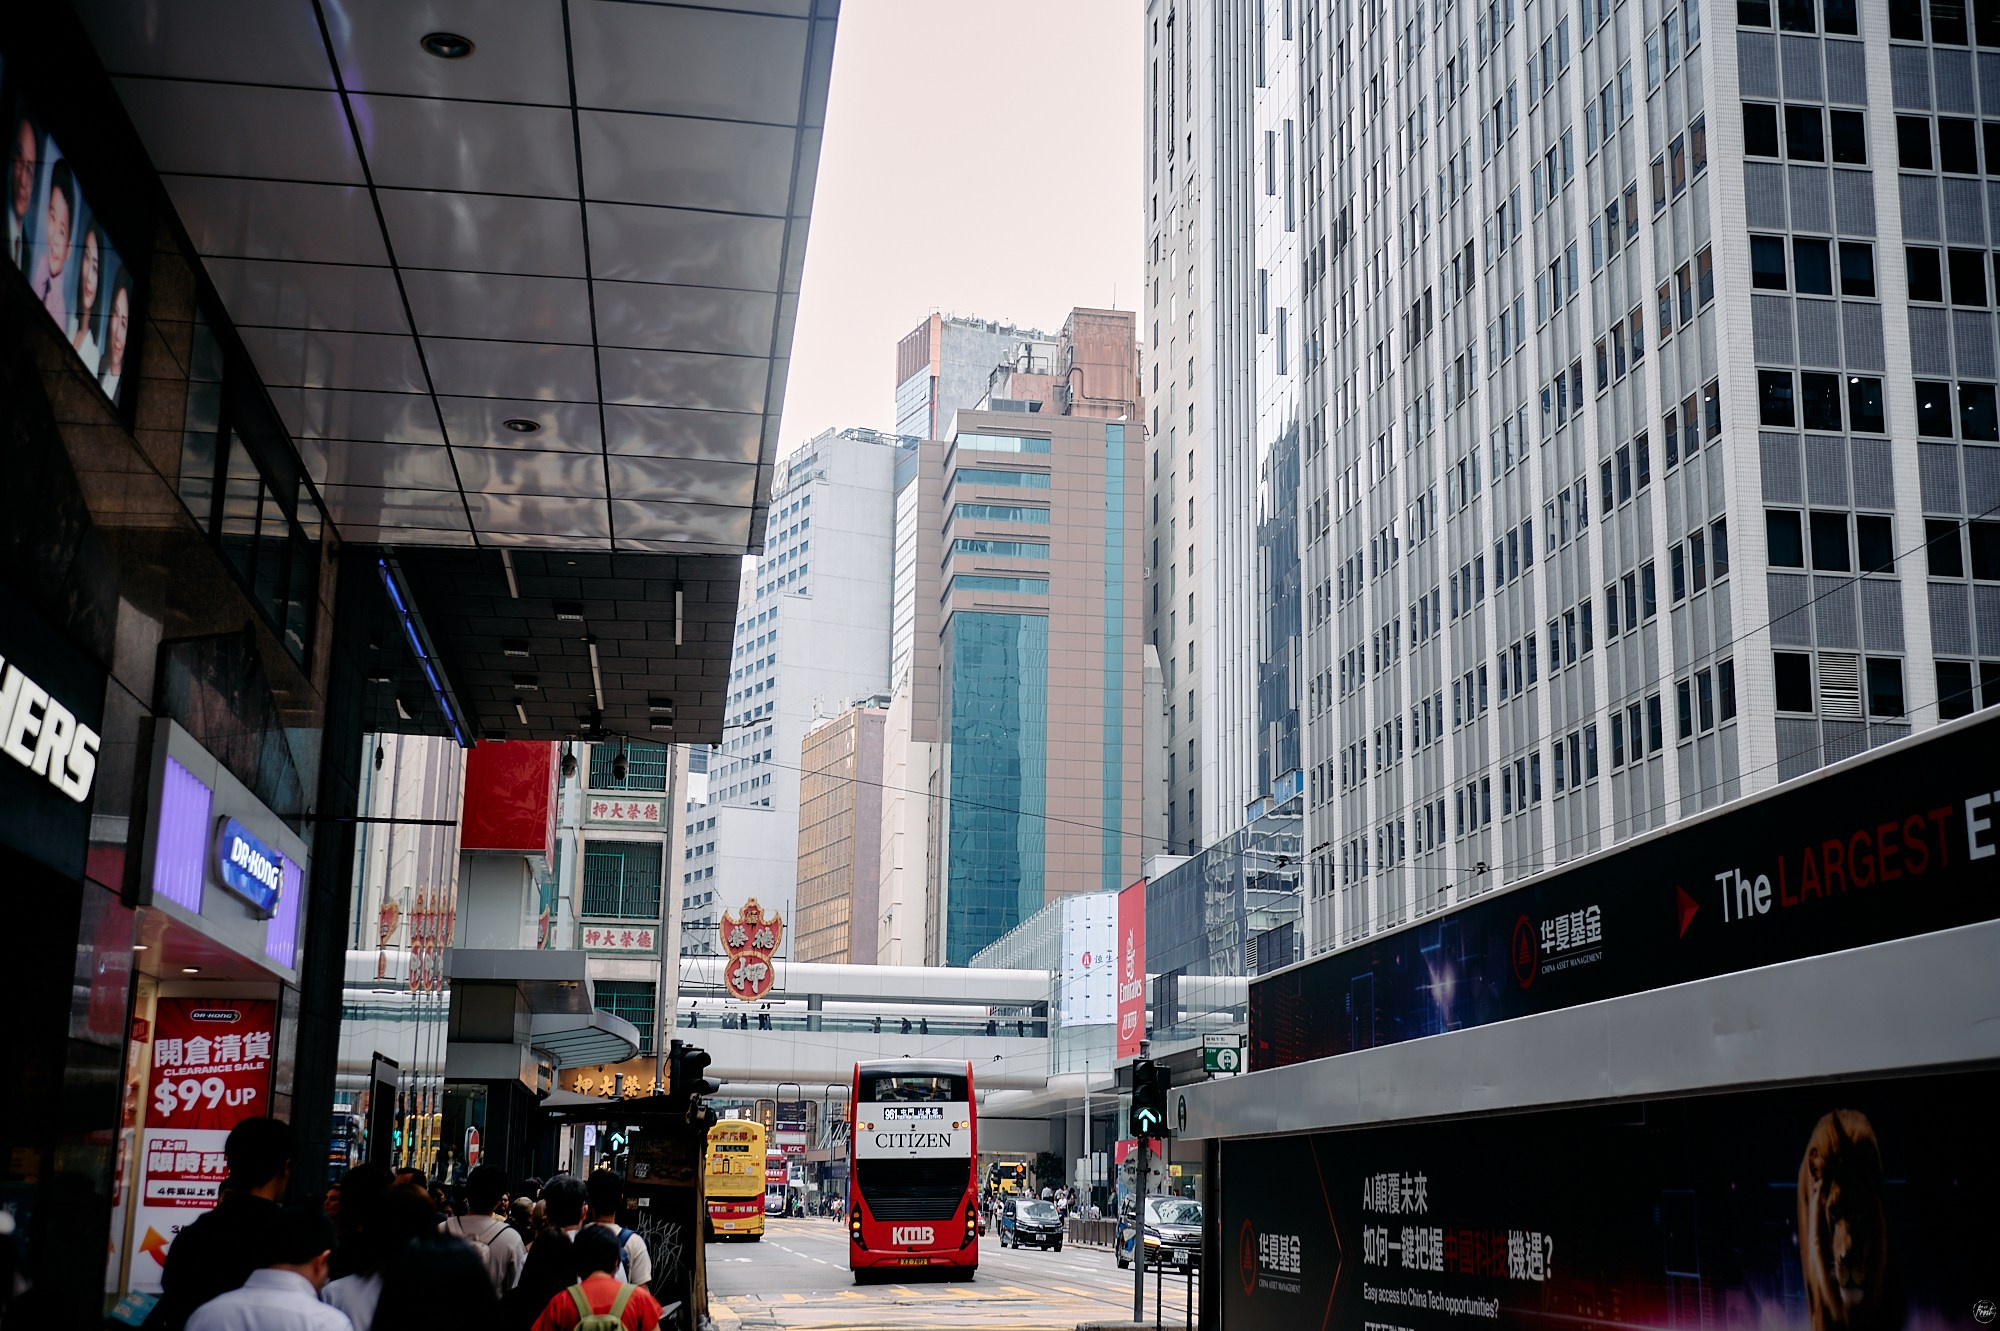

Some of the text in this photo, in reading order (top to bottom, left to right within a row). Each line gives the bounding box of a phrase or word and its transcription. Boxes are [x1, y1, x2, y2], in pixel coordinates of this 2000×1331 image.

[1715, 868, 1772, 922] The
[1778, 805, 1952, 908] LARGEST
[1540, 905, 1602, 954] 华夏基金
[1541, 951, 1603, 974] CHINA ASSET MANAGEMENT
[1120, 979, 1143, 1003] Emirates
[154, 1031, 271, 1068] 開倉清貨
[163, 1061, 265, 1077] CLEARANCE SALE
[154, 1077, 257, 1118] $99 UP
[884, 1108, 898, 1120] 961
[787, 1145, 803, 1153] KFC
[875, 1132, 952, 1149] CITIZEN
[892, 1226, 935, 1246] KMB
[1259, 1232, 1301, 1274] 华夏基金
[1363, 1282, 1499, 1319] Easy access to China Tech opportunities?
